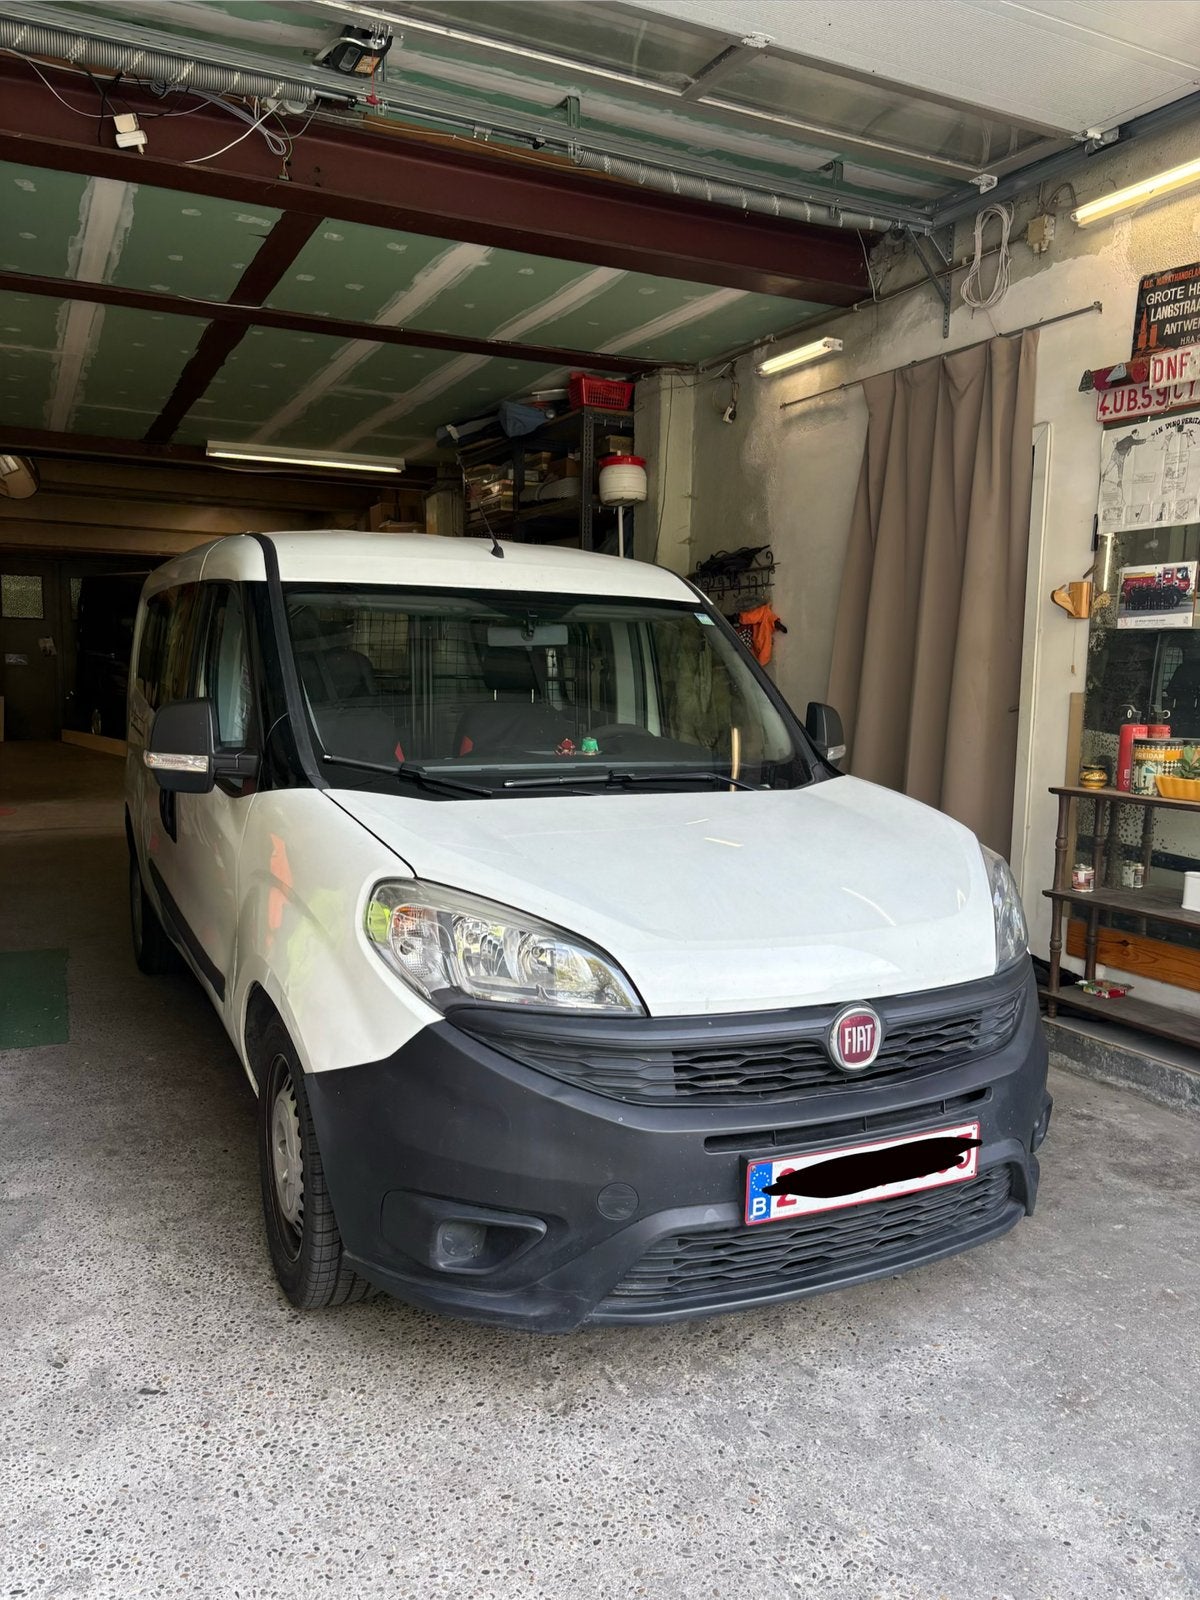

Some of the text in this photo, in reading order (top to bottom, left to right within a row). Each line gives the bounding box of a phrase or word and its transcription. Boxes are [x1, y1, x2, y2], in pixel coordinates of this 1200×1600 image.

[1146, 285, 1185, 305] GROTE
[1165, 419, 1180, 429] VINO
[844, 1023, 874, 1055] FIAT
[752, 1197, 767, 1216] B
